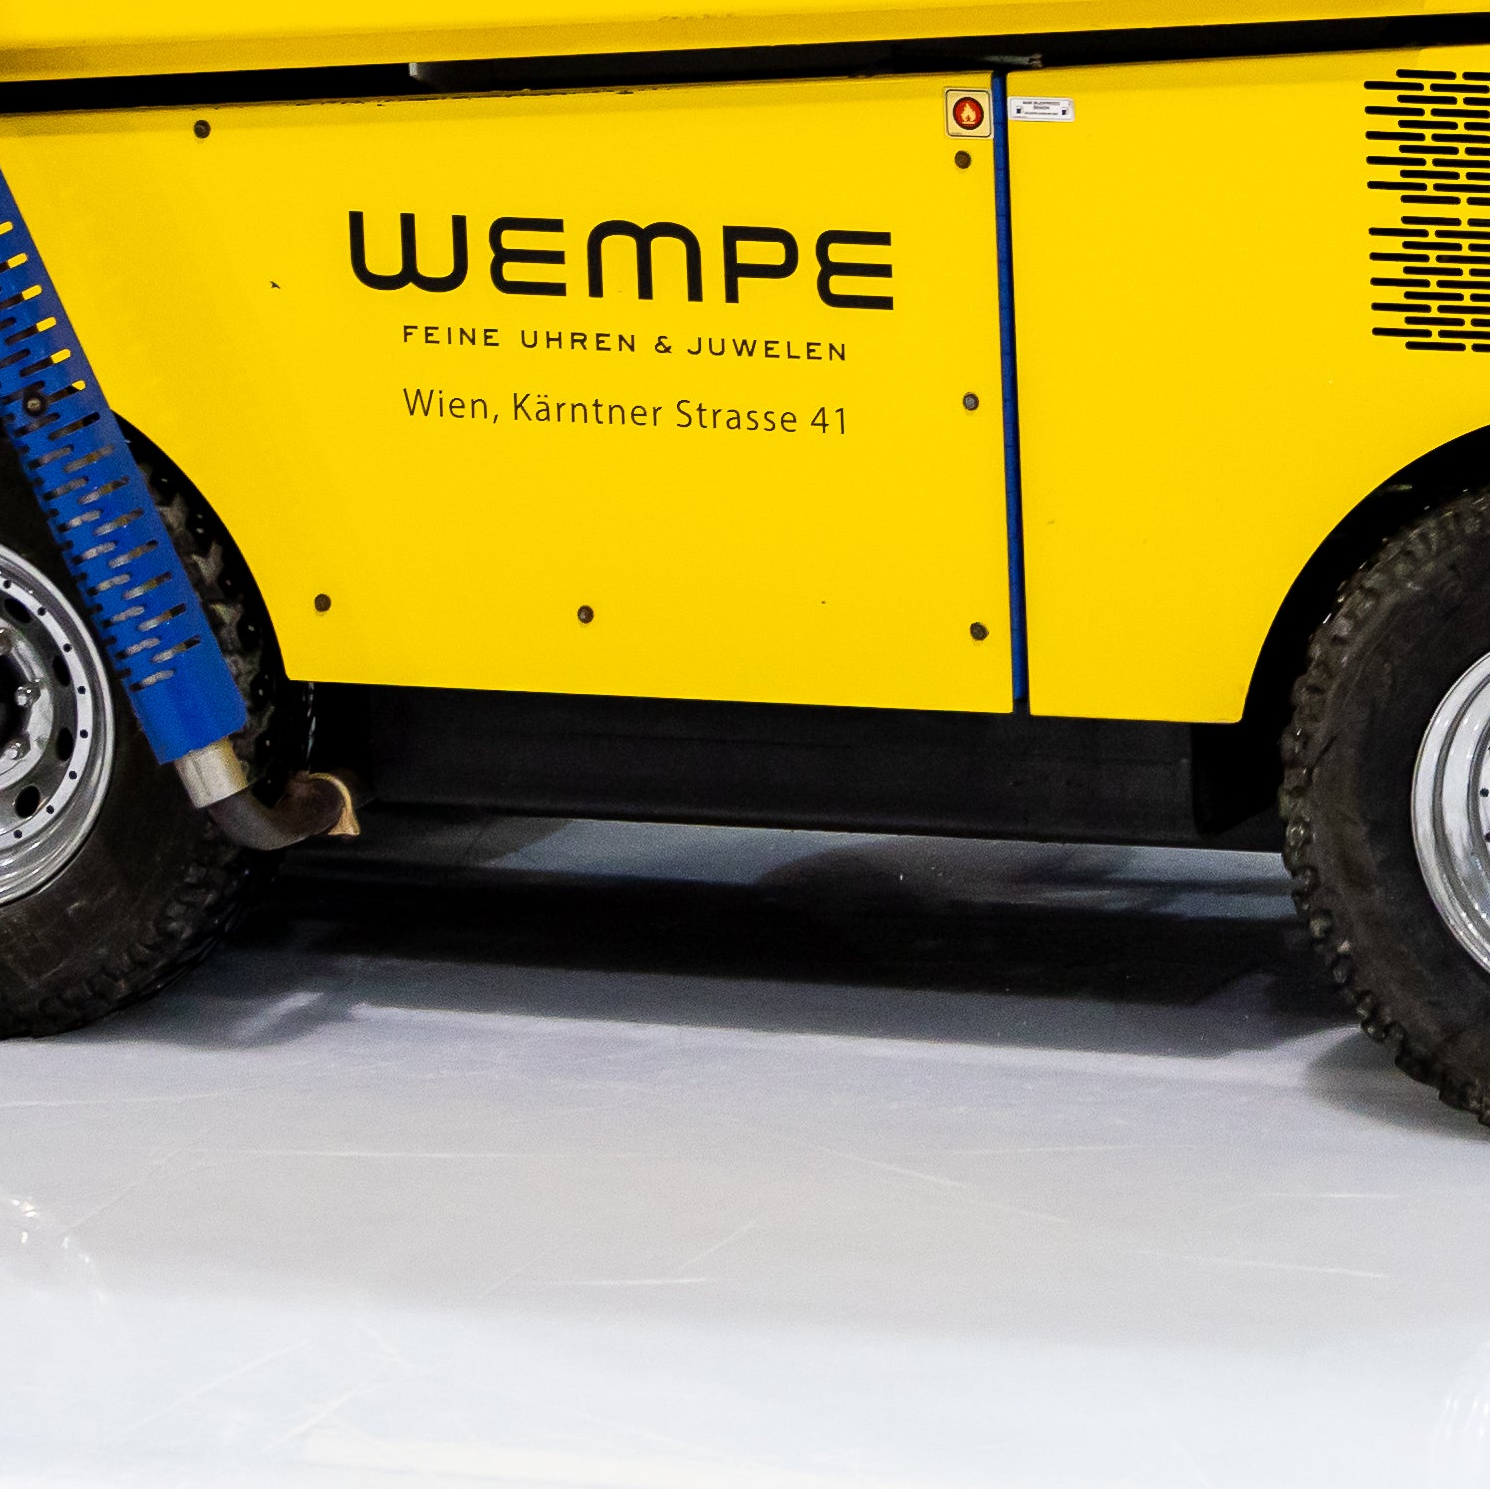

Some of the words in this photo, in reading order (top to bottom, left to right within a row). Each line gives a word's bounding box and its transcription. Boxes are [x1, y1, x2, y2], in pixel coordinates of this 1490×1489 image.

[348, 210, 894, 311] WEMPE
[403, 325, 500, 347] FEINE
[521, 329, 635, 353] UHREN
[654, 335, 672, 354] &
[687, 336, 847, 362] JUWELEN
[403, 388, 499, 425] Wien,
[513, 392, 663, 427] Kärntner
[676, 399, 798, 433] Strasse
[810, 406, 847, 435] 41
